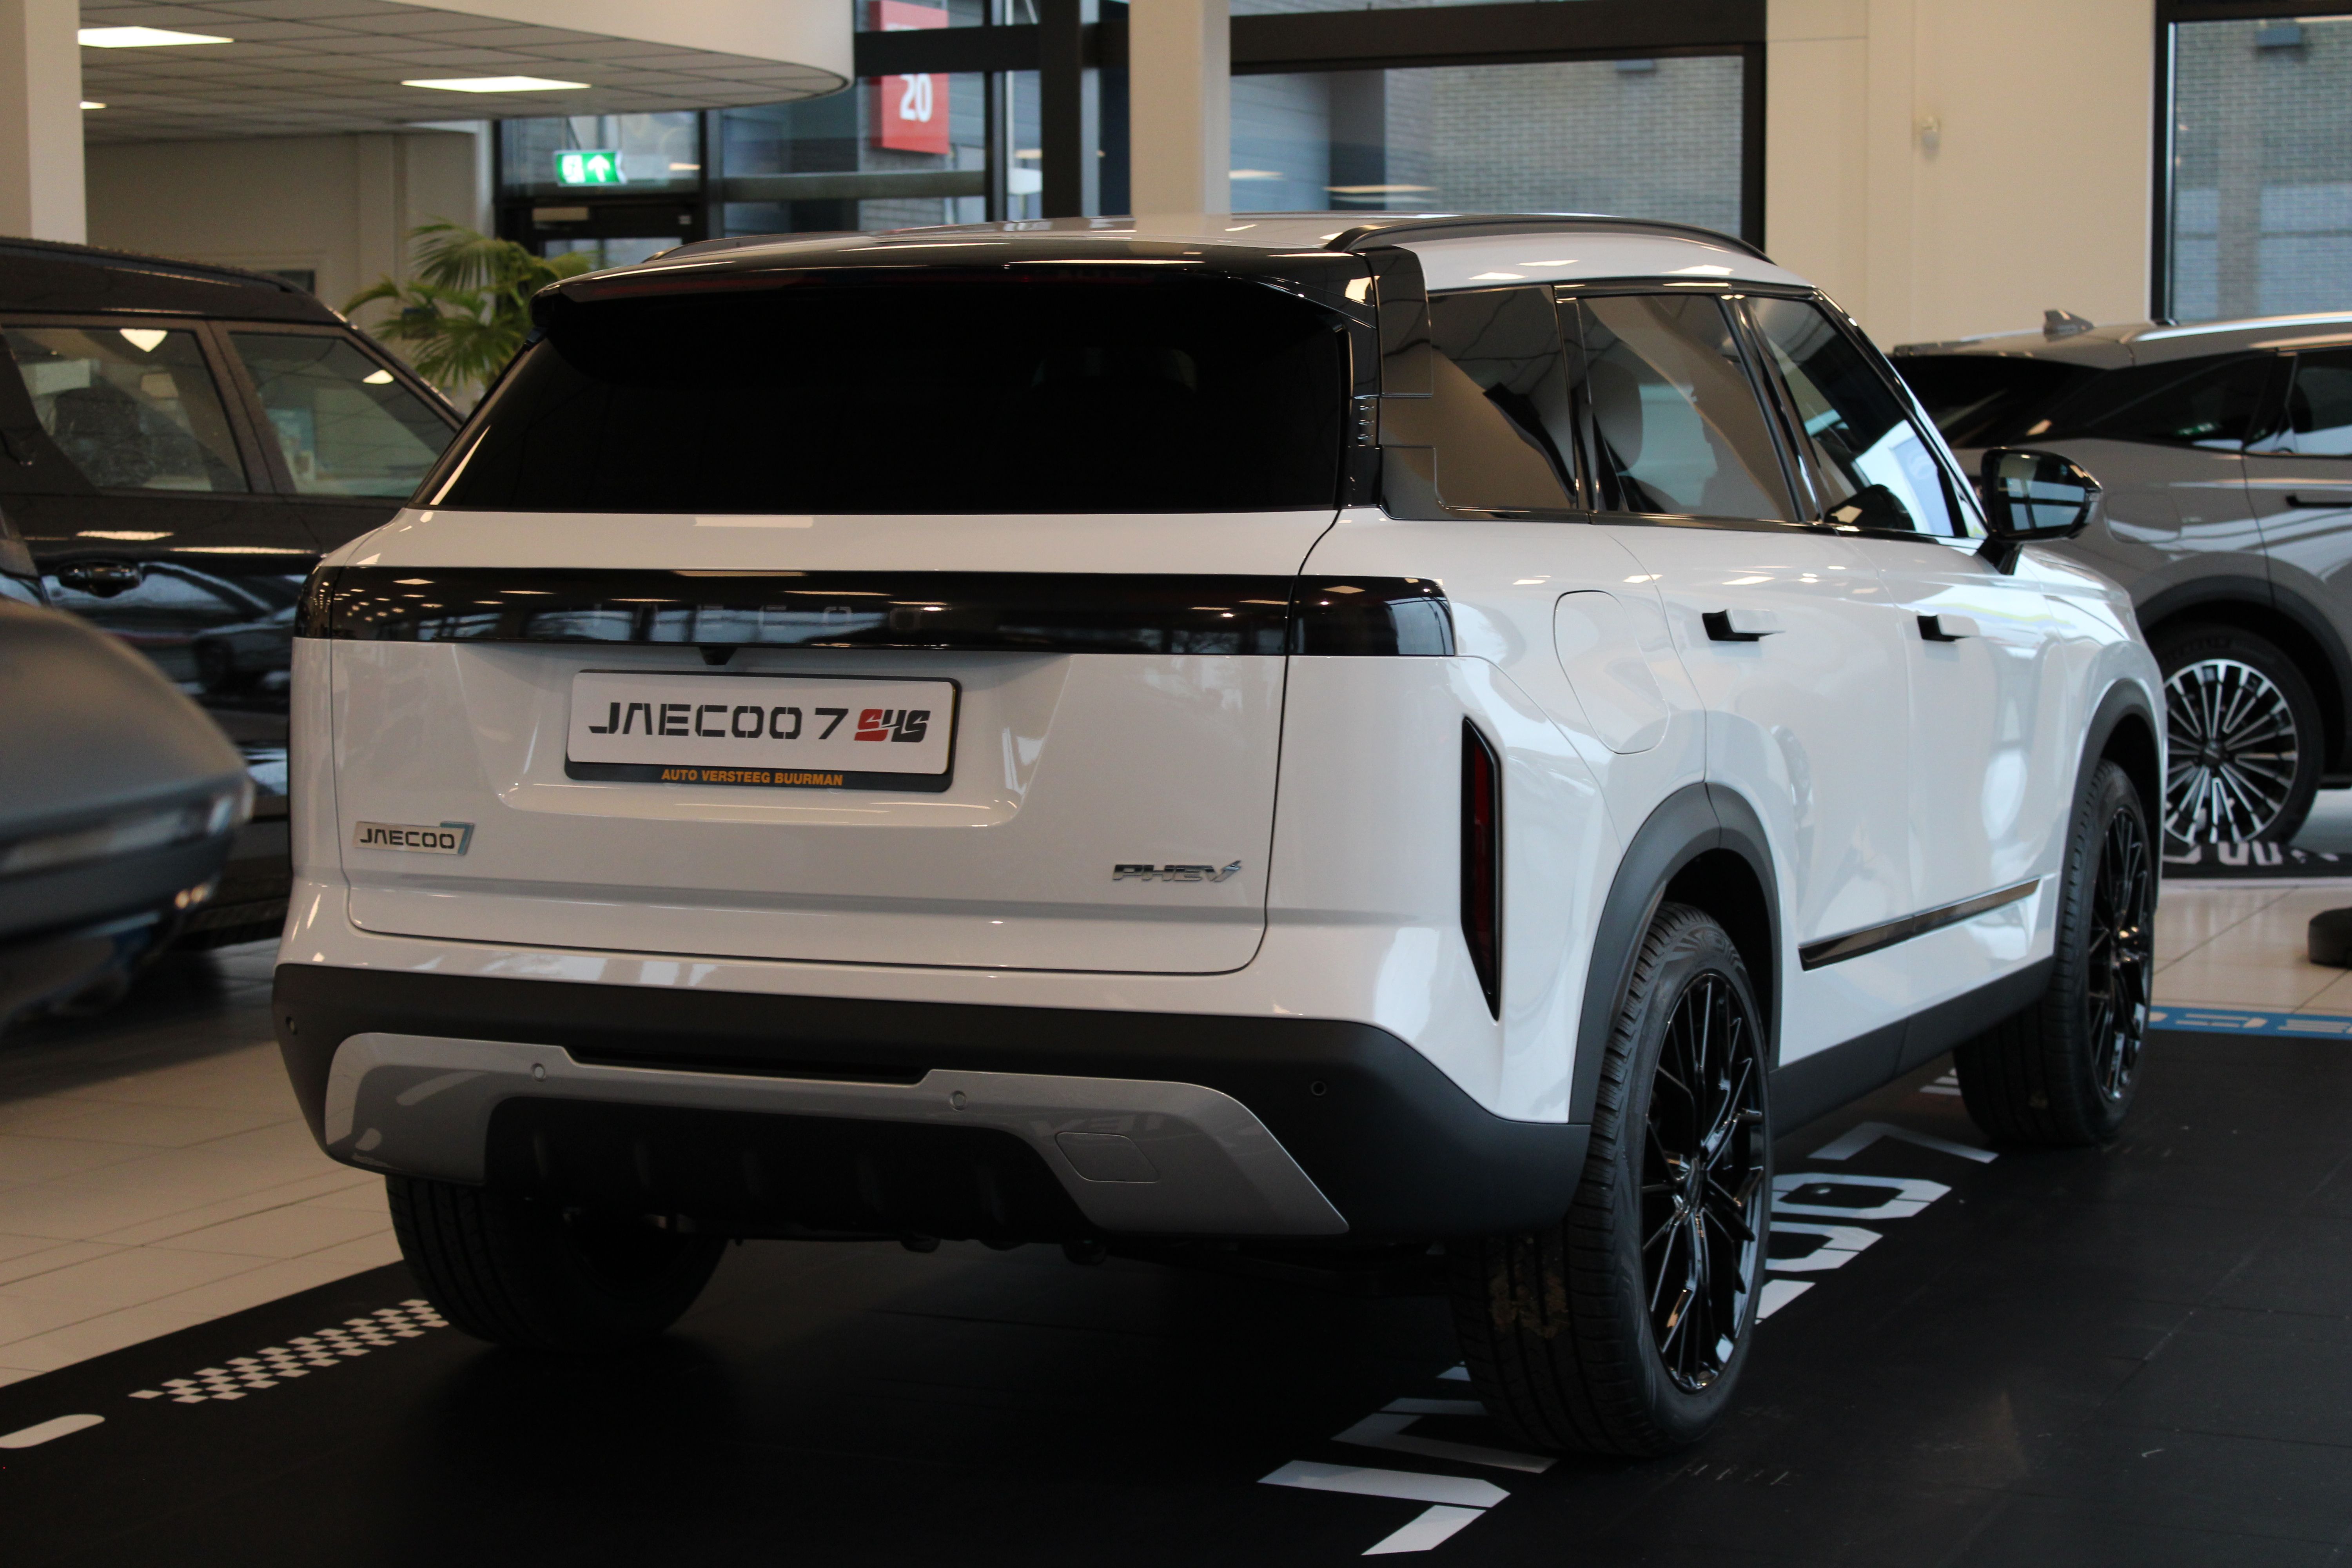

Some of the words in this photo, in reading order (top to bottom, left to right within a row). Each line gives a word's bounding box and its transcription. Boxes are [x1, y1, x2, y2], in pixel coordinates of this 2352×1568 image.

[900, 73, 933, 123] 20
[588, 702, 802, 739] JAECOO
[815, 707, 849, 740] 7
[661, 769, 698, 781] AUTO
[701, 770, 771, 783] VERSTEEG
[774, 772, 843, 786] BUURMAN
[359, 828, 455, 849] JAECOO
[1112, 860, 1241, 882] PHEV
